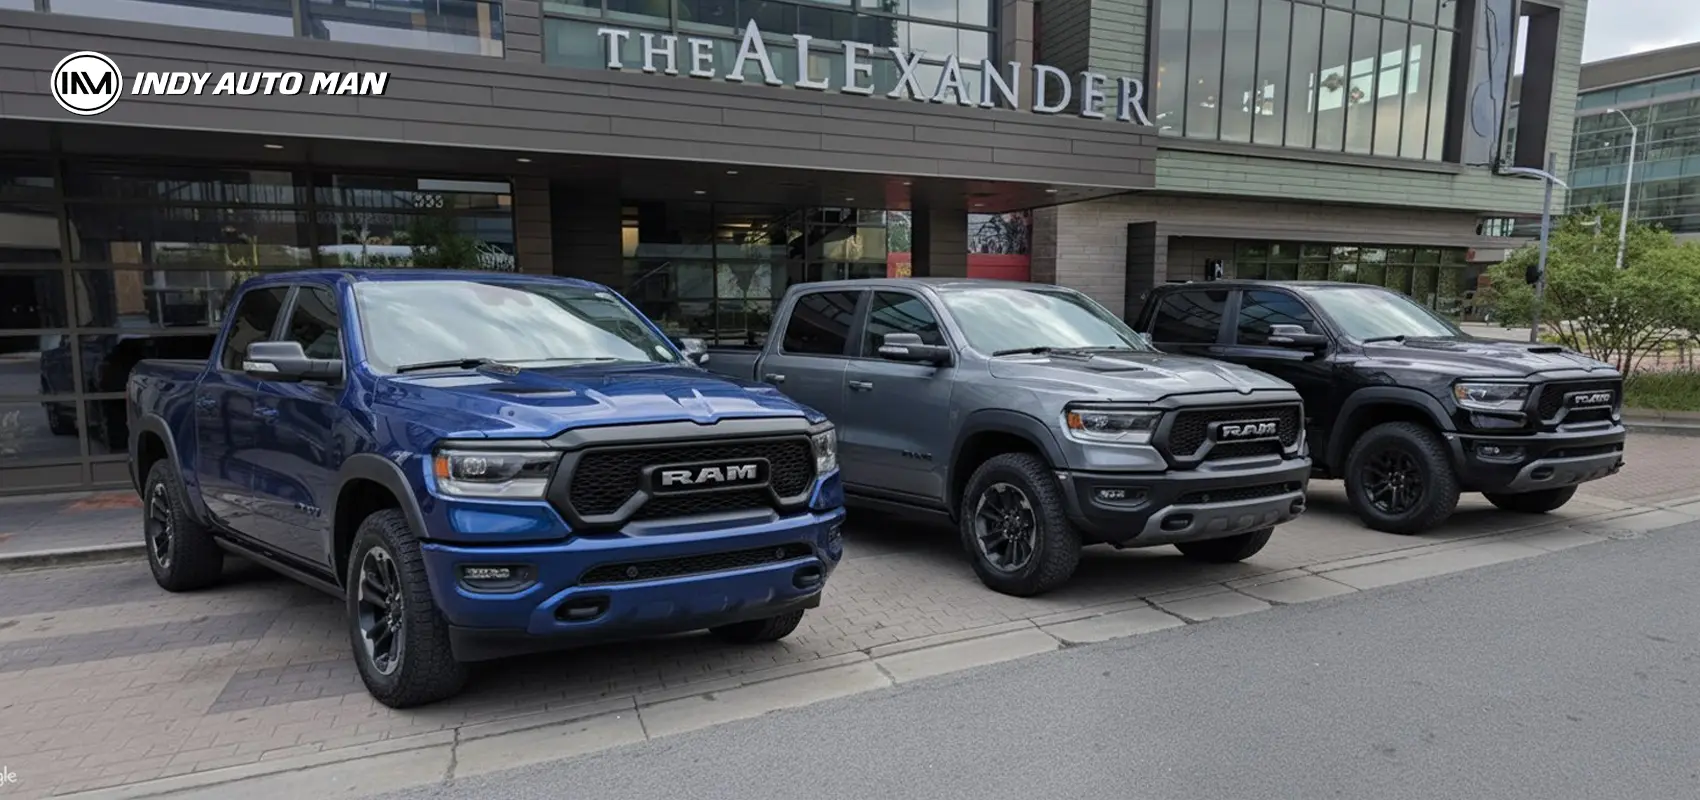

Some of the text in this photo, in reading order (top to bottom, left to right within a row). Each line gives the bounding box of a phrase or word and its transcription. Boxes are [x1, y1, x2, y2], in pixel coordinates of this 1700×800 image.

[597, 18, 1153, 126] THE ALEXANDER
[662, 464, 757, 486] RAM
